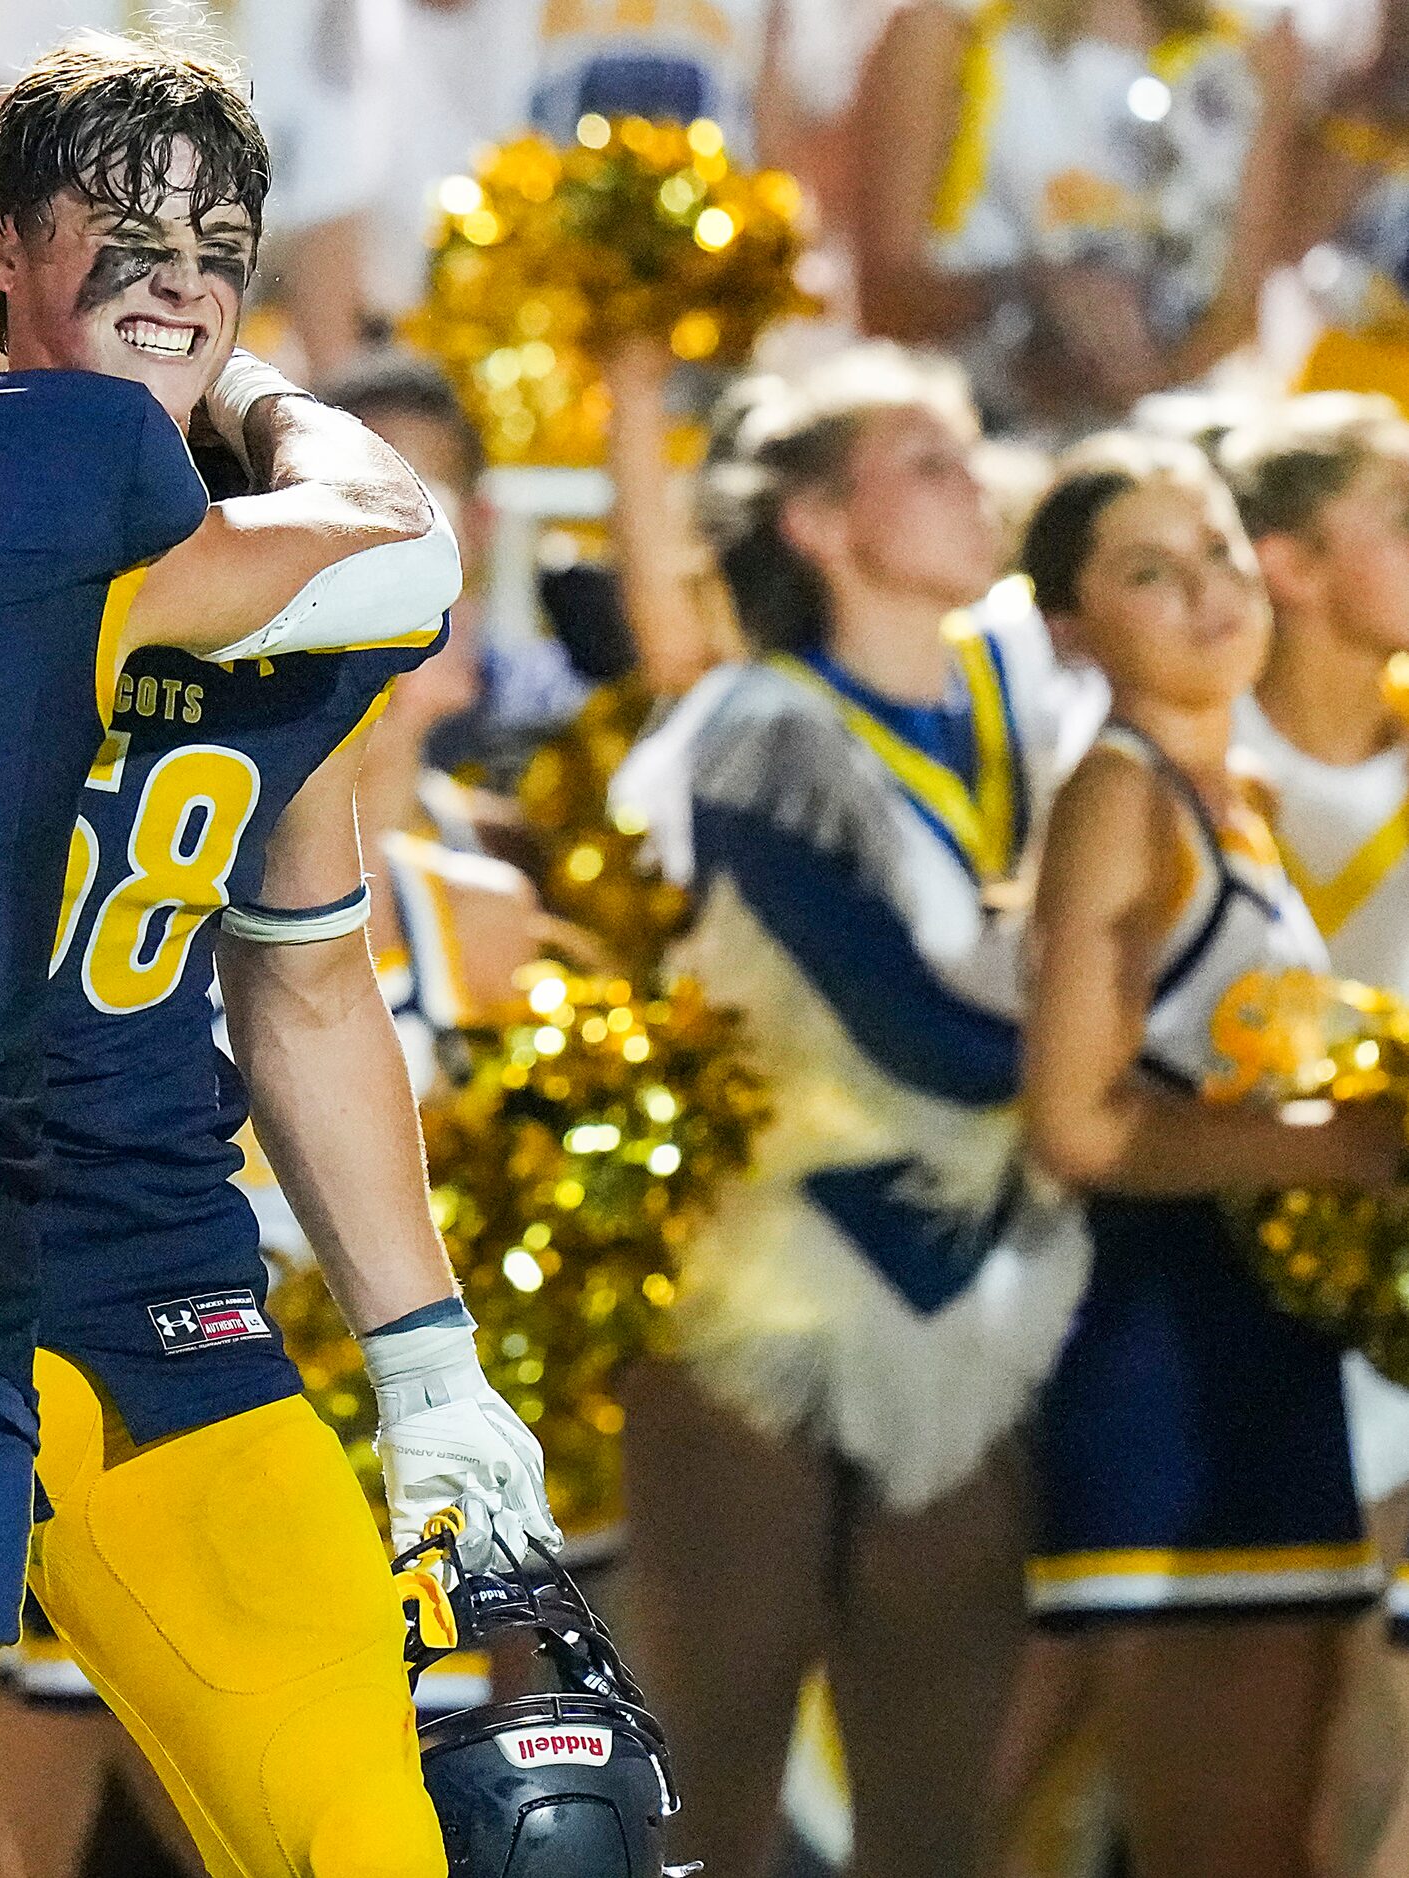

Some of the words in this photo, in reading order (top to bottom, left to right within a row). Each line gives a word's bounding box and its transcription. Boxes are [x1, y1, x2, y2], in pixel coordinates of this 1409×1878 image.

[114, 673, 204, 723] COTS
[196, 1301, 224, 1310] UNDER
[205, 1319, 244, 1334] AUTHENTIC
[391, 1443, 434, 1457] ARMO
[437, 1450, 480, 1465] UNDER
[478, 1589, 508, 1602] Ridd
[518, 1735, 604, 1760] Riddell
